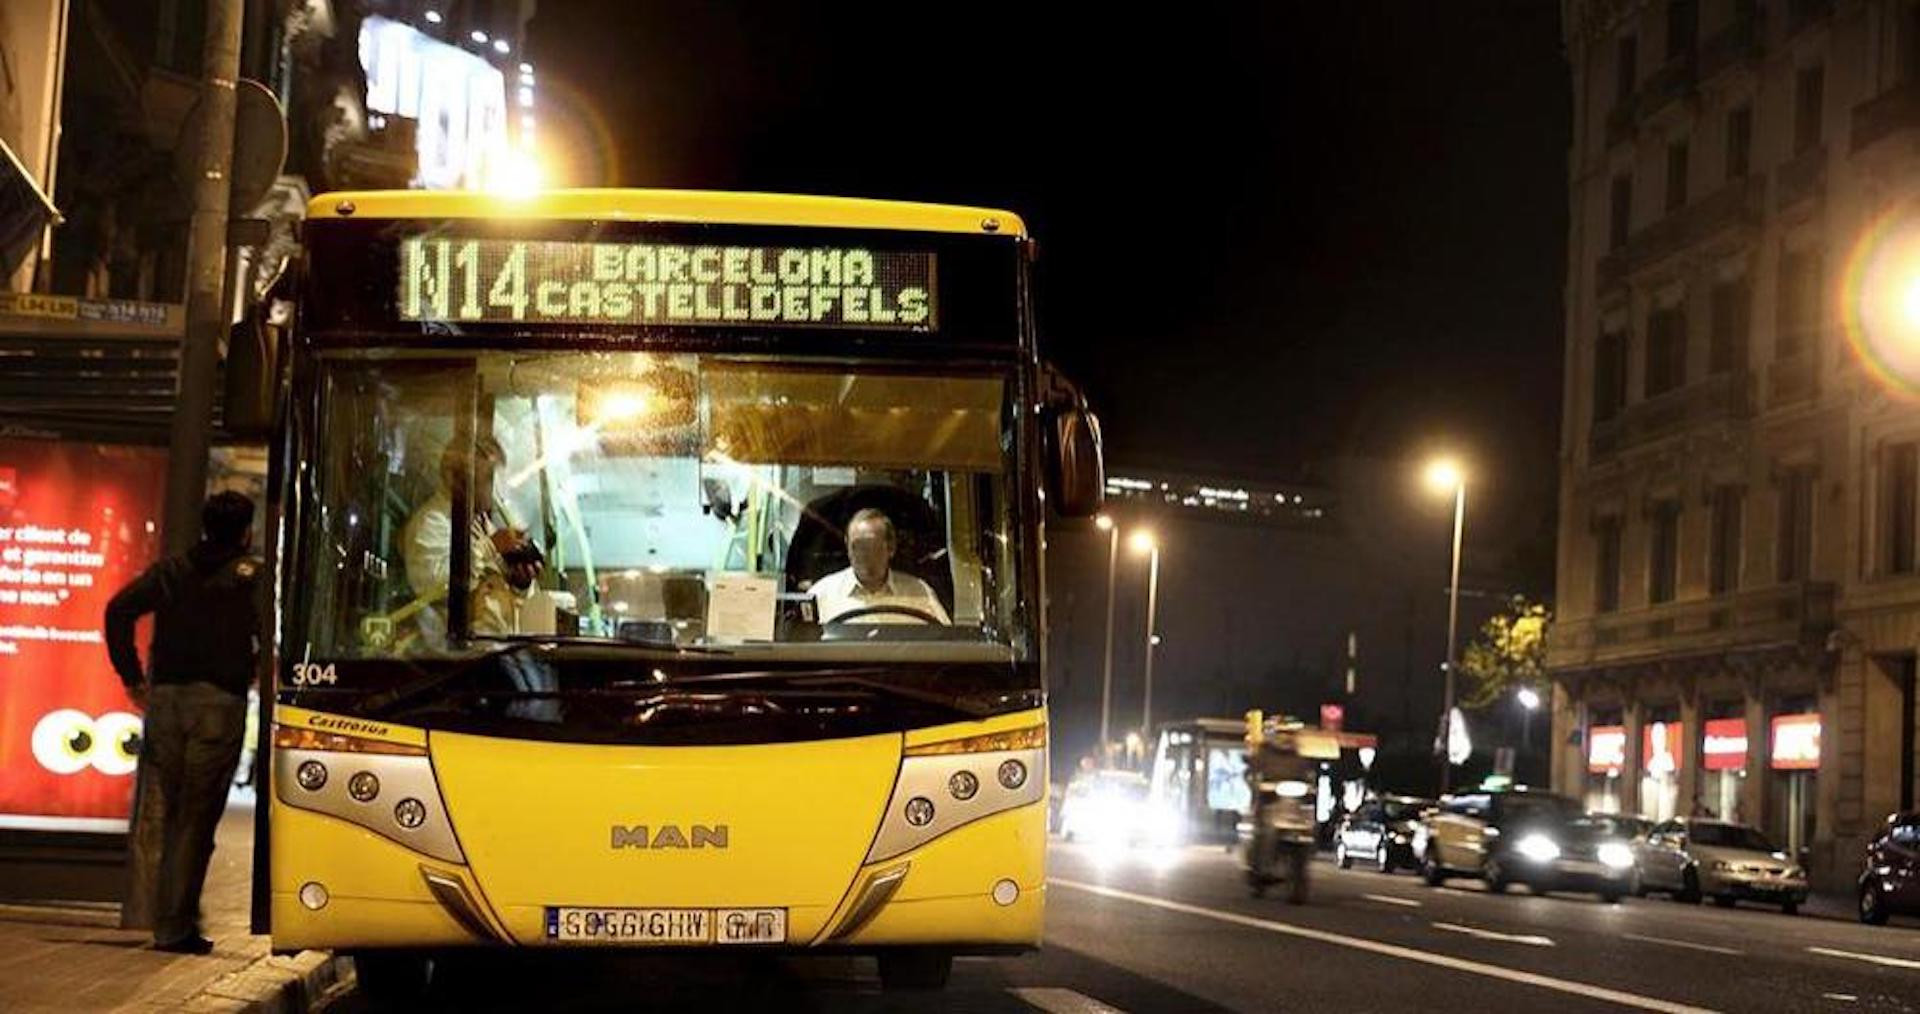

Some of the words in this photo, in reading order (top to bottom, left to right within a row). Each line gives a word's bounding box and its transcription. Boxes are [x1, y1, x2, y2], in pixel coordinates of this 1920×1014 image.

[405, 239, 530, 321] N14
[535, 280, 930, 325] CASTELLDEFELS
[292, 662, 338, 686] 304
[307, 713, 390, 738] Castrosua
[610, 825, 730, 849] MAN
